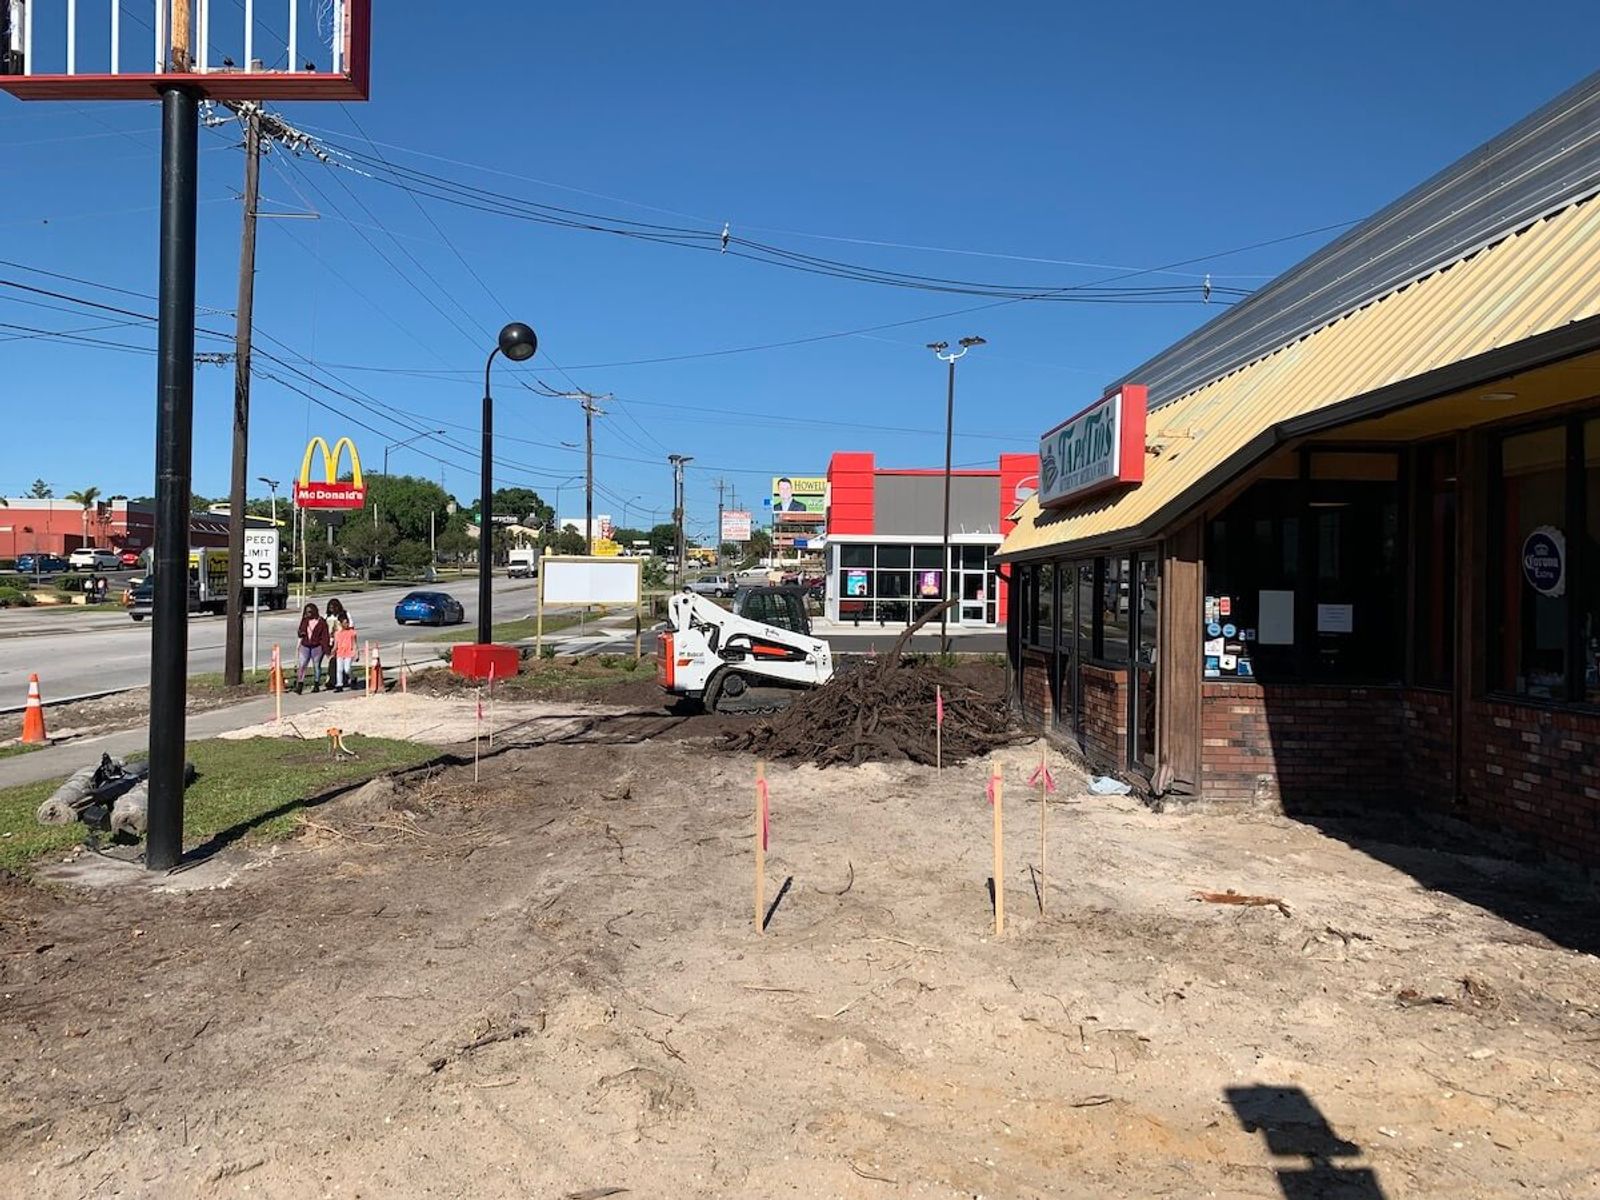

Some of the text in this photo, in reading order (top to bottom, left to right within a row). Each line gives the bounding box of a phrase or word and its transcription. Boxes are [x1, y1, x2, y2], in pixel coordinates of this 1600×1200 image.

[298, 490, 363, 500] McDonald's
[245, 535, 274, 544] PEED
[1524, 554, 1559, 569] Corona
[243, 562, 272, 579] 35
[1534, 567, 1554, 579] Extra
